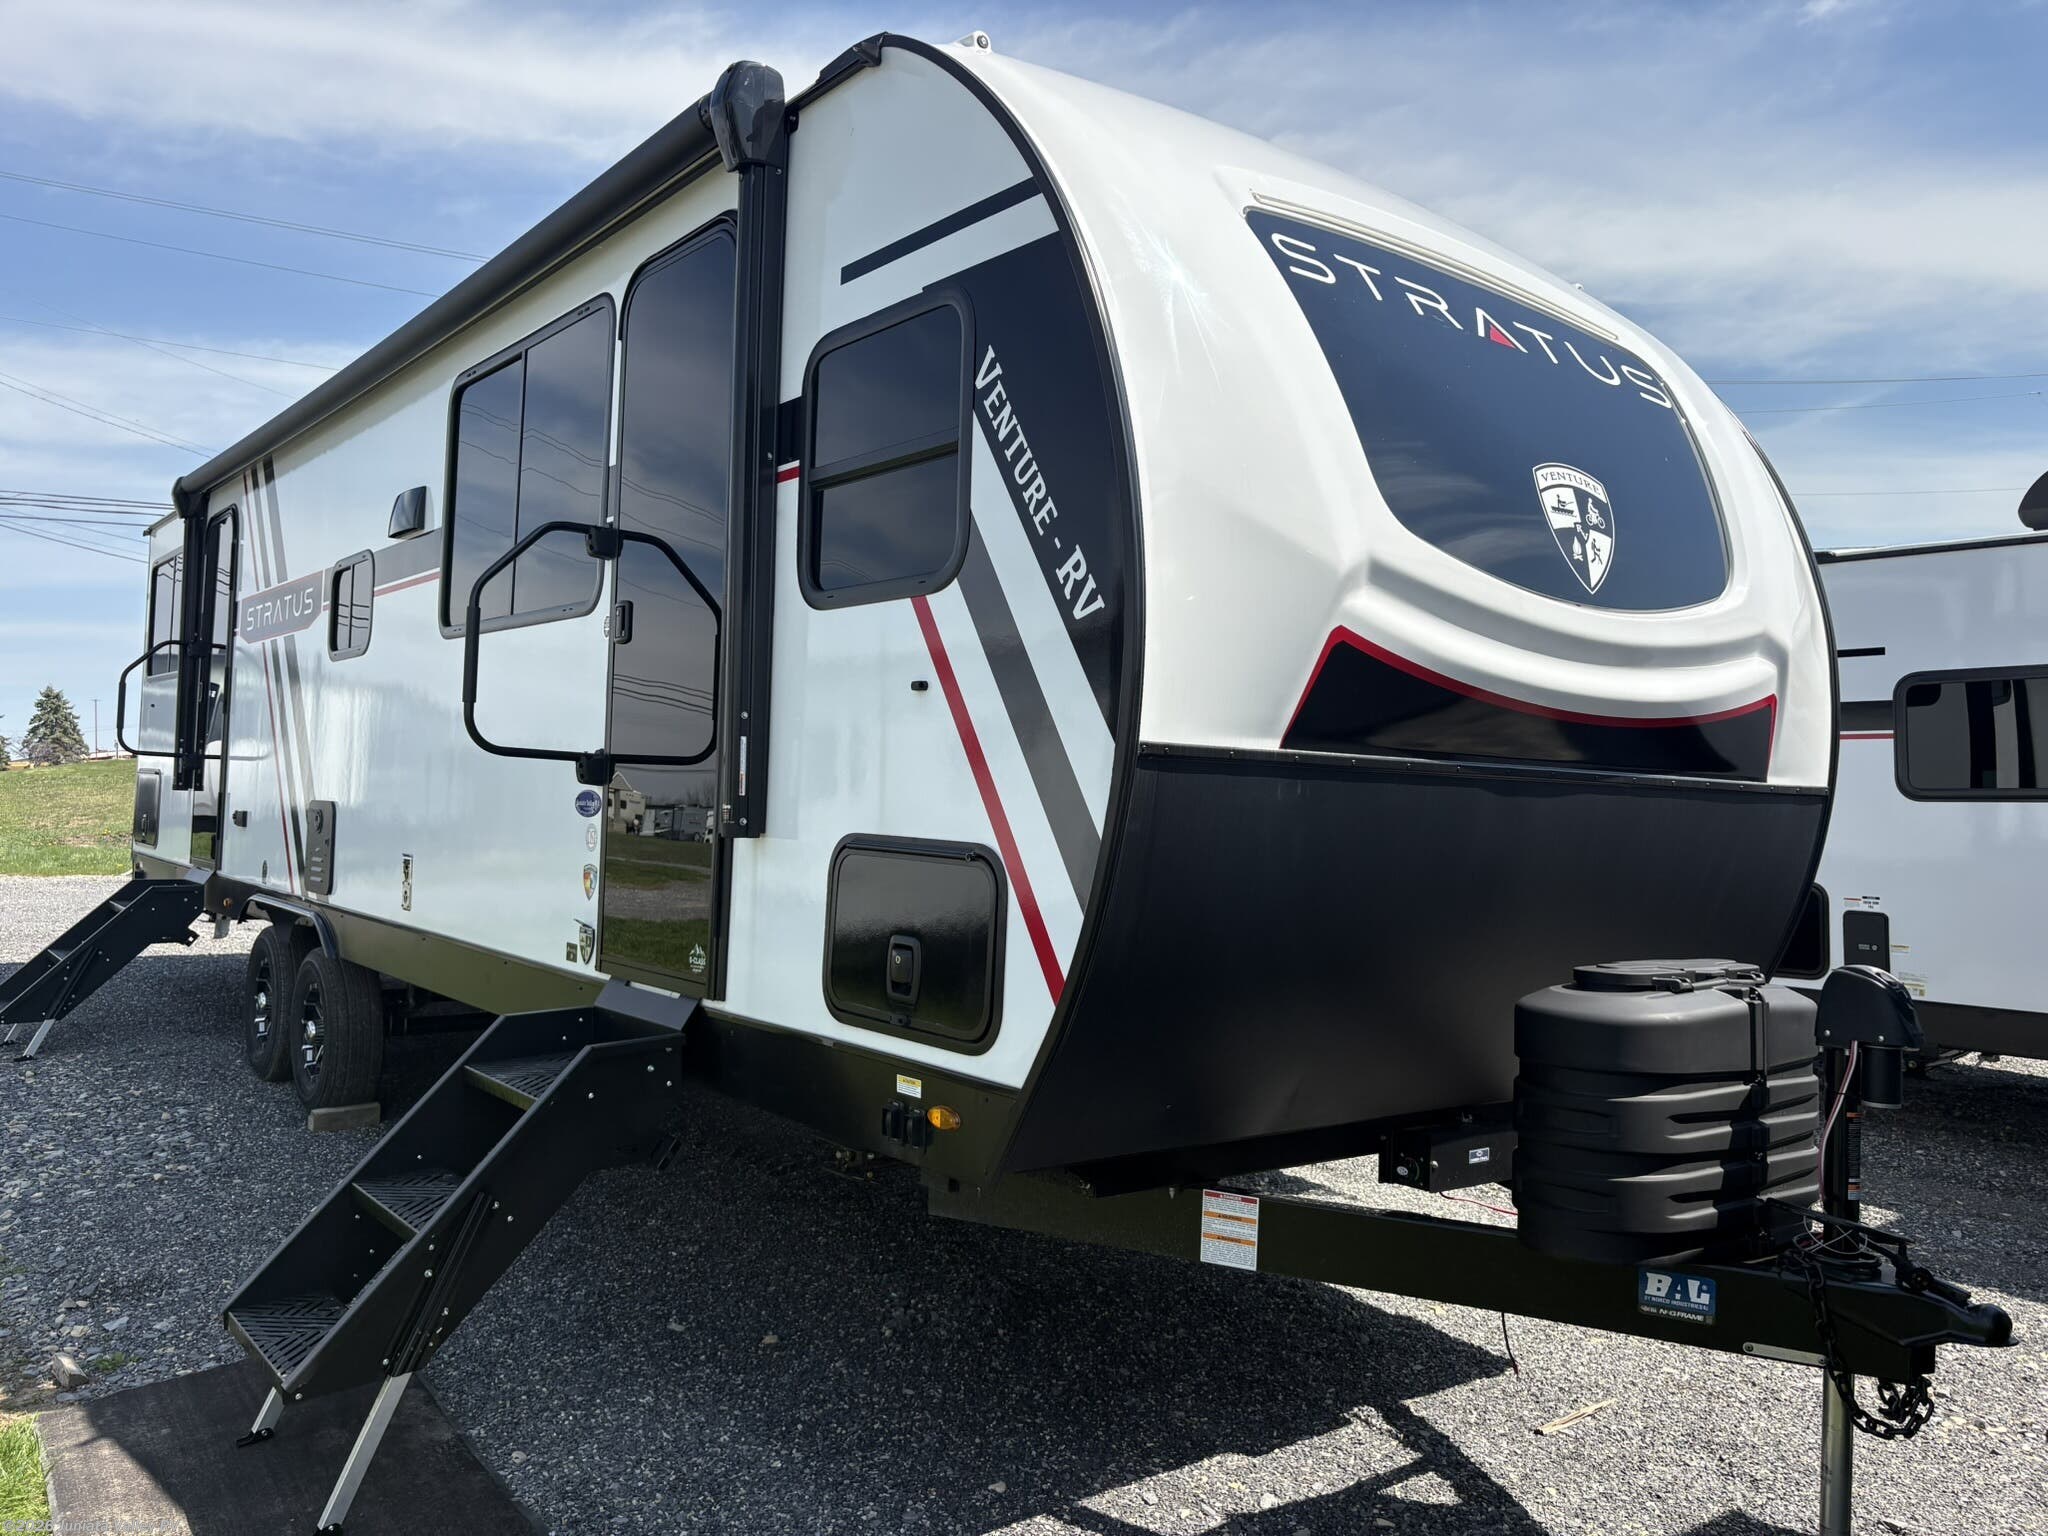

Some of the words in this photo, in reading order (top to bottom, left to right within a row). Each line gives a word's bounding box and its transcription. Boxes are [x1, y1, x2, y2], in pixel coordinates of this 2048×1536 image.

[1271, 232, 1672, 409] STRATUS
[974, 344, 1058, 535] VENTURE
[1056, 543, 1105, 620] RV
[1541, 471, 1600, 496] VENTURE
[1575, 523, 1588, 541] RV
[246, 587, 314, 632] STRATUS
